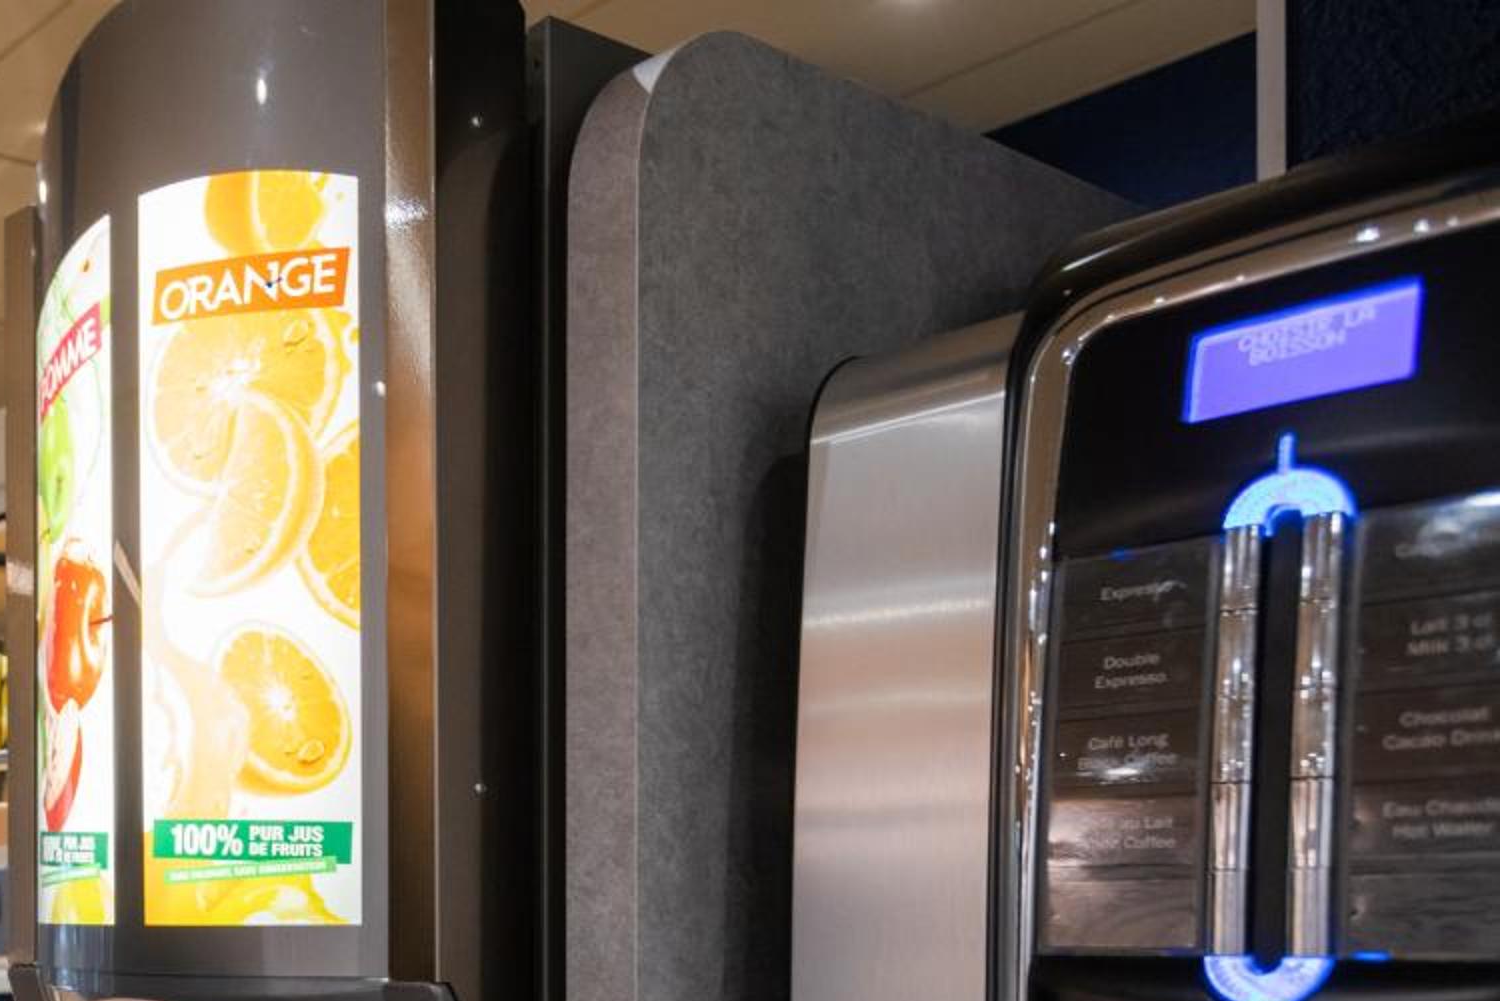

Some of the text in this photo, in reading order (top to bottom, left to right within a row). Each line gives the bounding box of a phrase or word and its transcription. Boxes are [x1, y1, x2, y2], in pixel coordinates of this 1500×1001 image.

[159, 253, 337, 319] ORANGE
[1104, 653, 1160, 671] Double
[1094, 672, 1168, 690] Expresso
[1127, 733, 1170, 752] Long
[170, 823, 243, 857] 100%
[249, 825, 325, 843] PUR JUS
[248, 842, 324, 857] DE FRUITS
